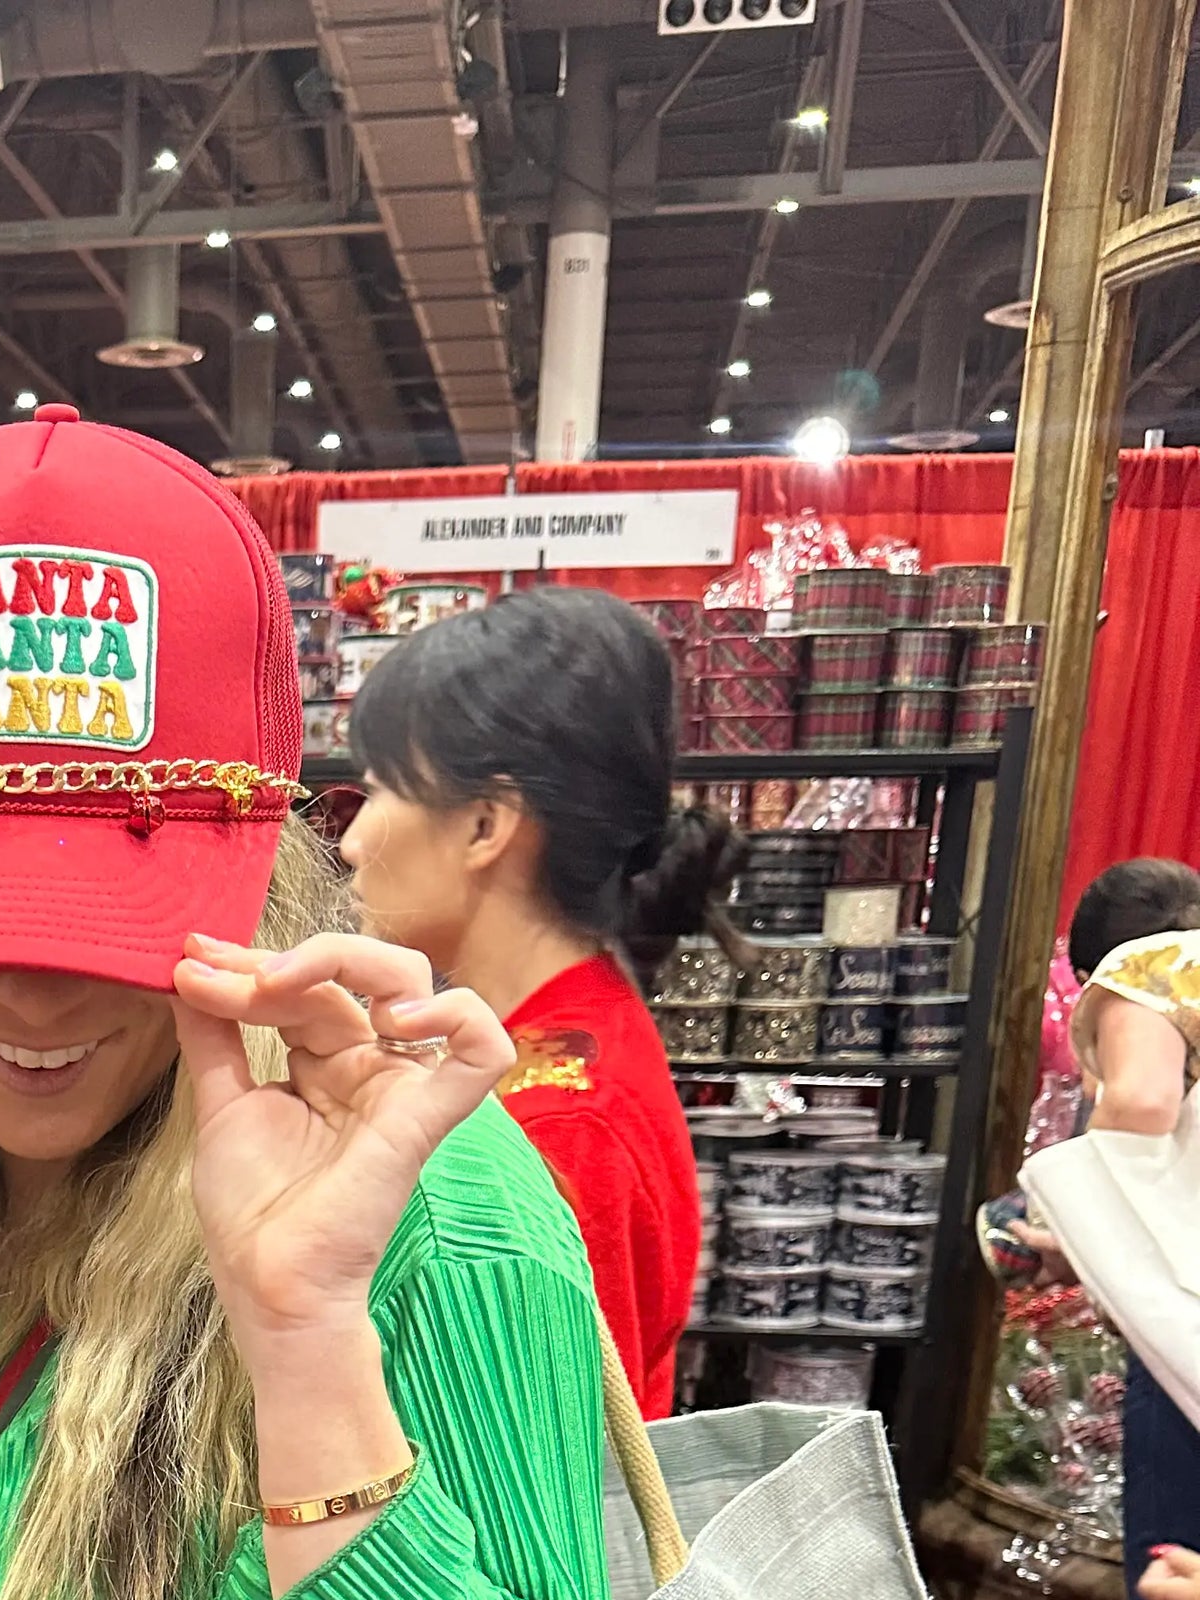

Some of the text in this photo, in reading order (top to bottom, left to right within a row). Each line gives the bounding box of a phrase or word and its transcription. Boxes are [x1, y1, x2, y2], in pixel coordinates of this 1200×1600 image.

[421, 513, 627, 542] ALEXANDER AND COMPANY
